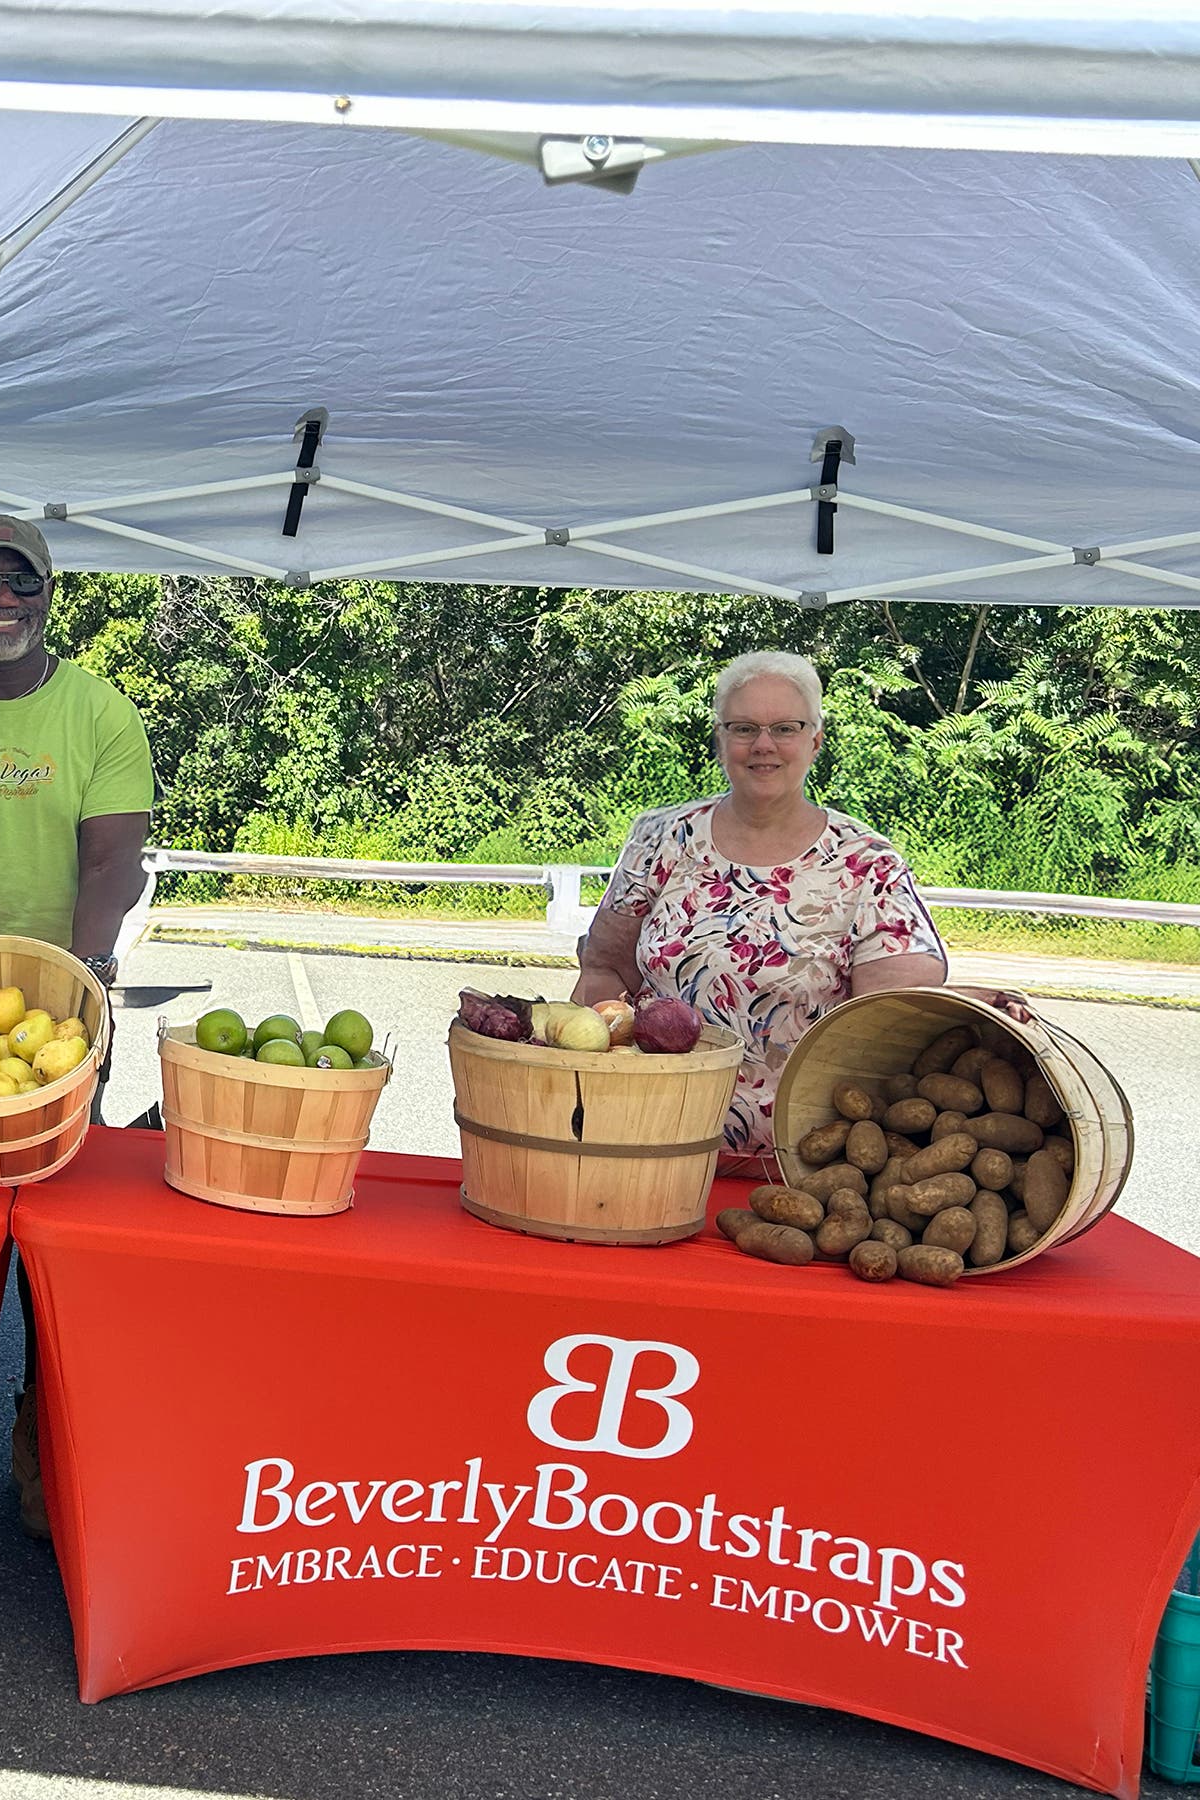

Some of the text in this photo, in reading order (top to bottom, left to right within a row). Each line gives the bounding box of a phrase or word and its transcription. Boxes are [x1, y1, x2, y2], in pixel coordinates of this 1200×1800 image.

[225, 1544, 969, 1669] EMBRACE EDUCATE EMPOWER
